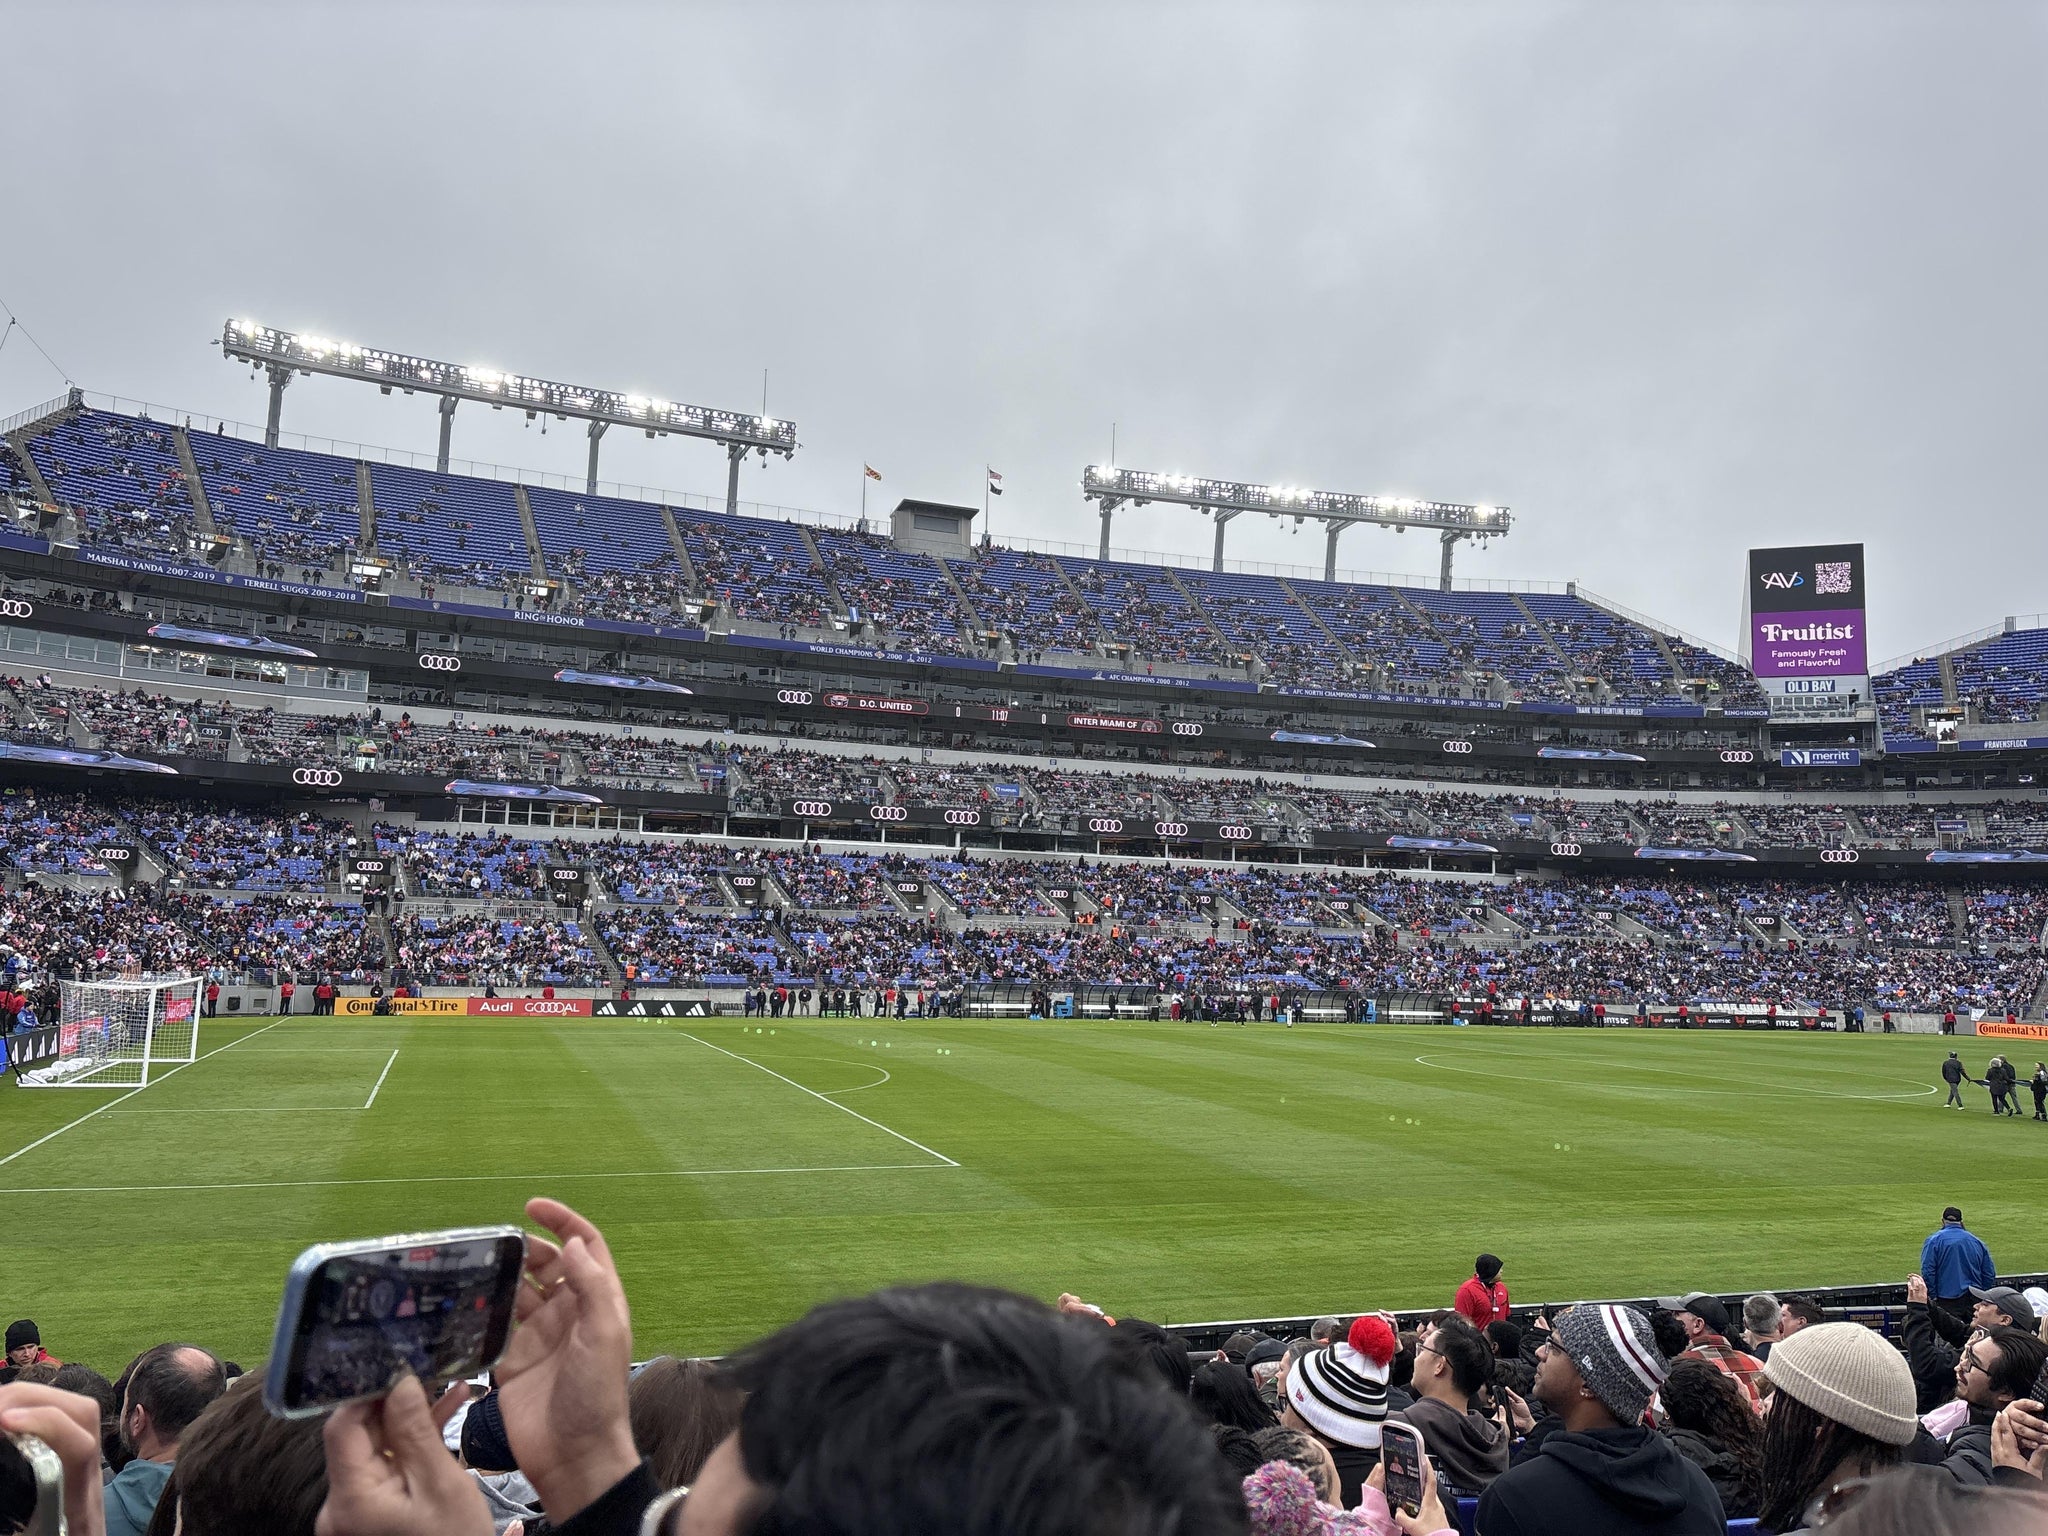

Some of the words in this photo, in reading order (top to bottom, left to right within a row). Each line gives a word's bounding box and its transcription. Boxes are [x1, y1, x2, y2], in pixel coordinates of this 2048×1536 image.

[86, 553, 130, 568] MARSHAL
[132, 561, 164, 574] YANDA
[166, 567, 216, 581] 2007-2019
[243, 579, 280, 591] TERRELL
[281, 584, 309, 596] SUGGS
[311, 588, 356, 600] 2003-2018
[514, 611, 539, 621] RING
[546, 614, 585, 627] HONOR
[1760, 622, 1854, 642] Fruitist
[809, 644, 834, 654] WORLD
[835, 648, 873, 658] CHAMPIONS
[916, 656, 932, 664] 2012
[1771, 649, 1816, 658] Famously
[1819, 648, 1847, 656] Fresh
[1778, 659, 1795, 667] and
[1798, 658, 1841, 667] Flavorful
[1121, 675, 1155, 683] CHAMPIONS
[1787, 681, 1809, 692] OLD
[1812, 680, 1833, 692] BAY
[1324, 690, 1357, 698] CHAMPIONS
[860, 700, 877, 708] D.C.
[880, 702, 913, 711] UNITED
[956, 706, 961, 718] 0
[992, 710, 1008, 721] 11:07
[1041, 714, 1047, 724] 0
[1074, 717, 1098, 725] INTER
[1100, 719, 1126, 728] MIAMI
[1576, 706, 1591, 714] THANK
[1601, 707, 1624, 715] FRONTLINE
[1984, 739, 2028, 748] #RAVENSFLOCK
[1812, 751, 1850, 760] merritt
[429, 1000, 458, 1011] Tire
[480, 1002, 514, 1012] Audi
[1979, 1023, 2029, 1035] Continental
